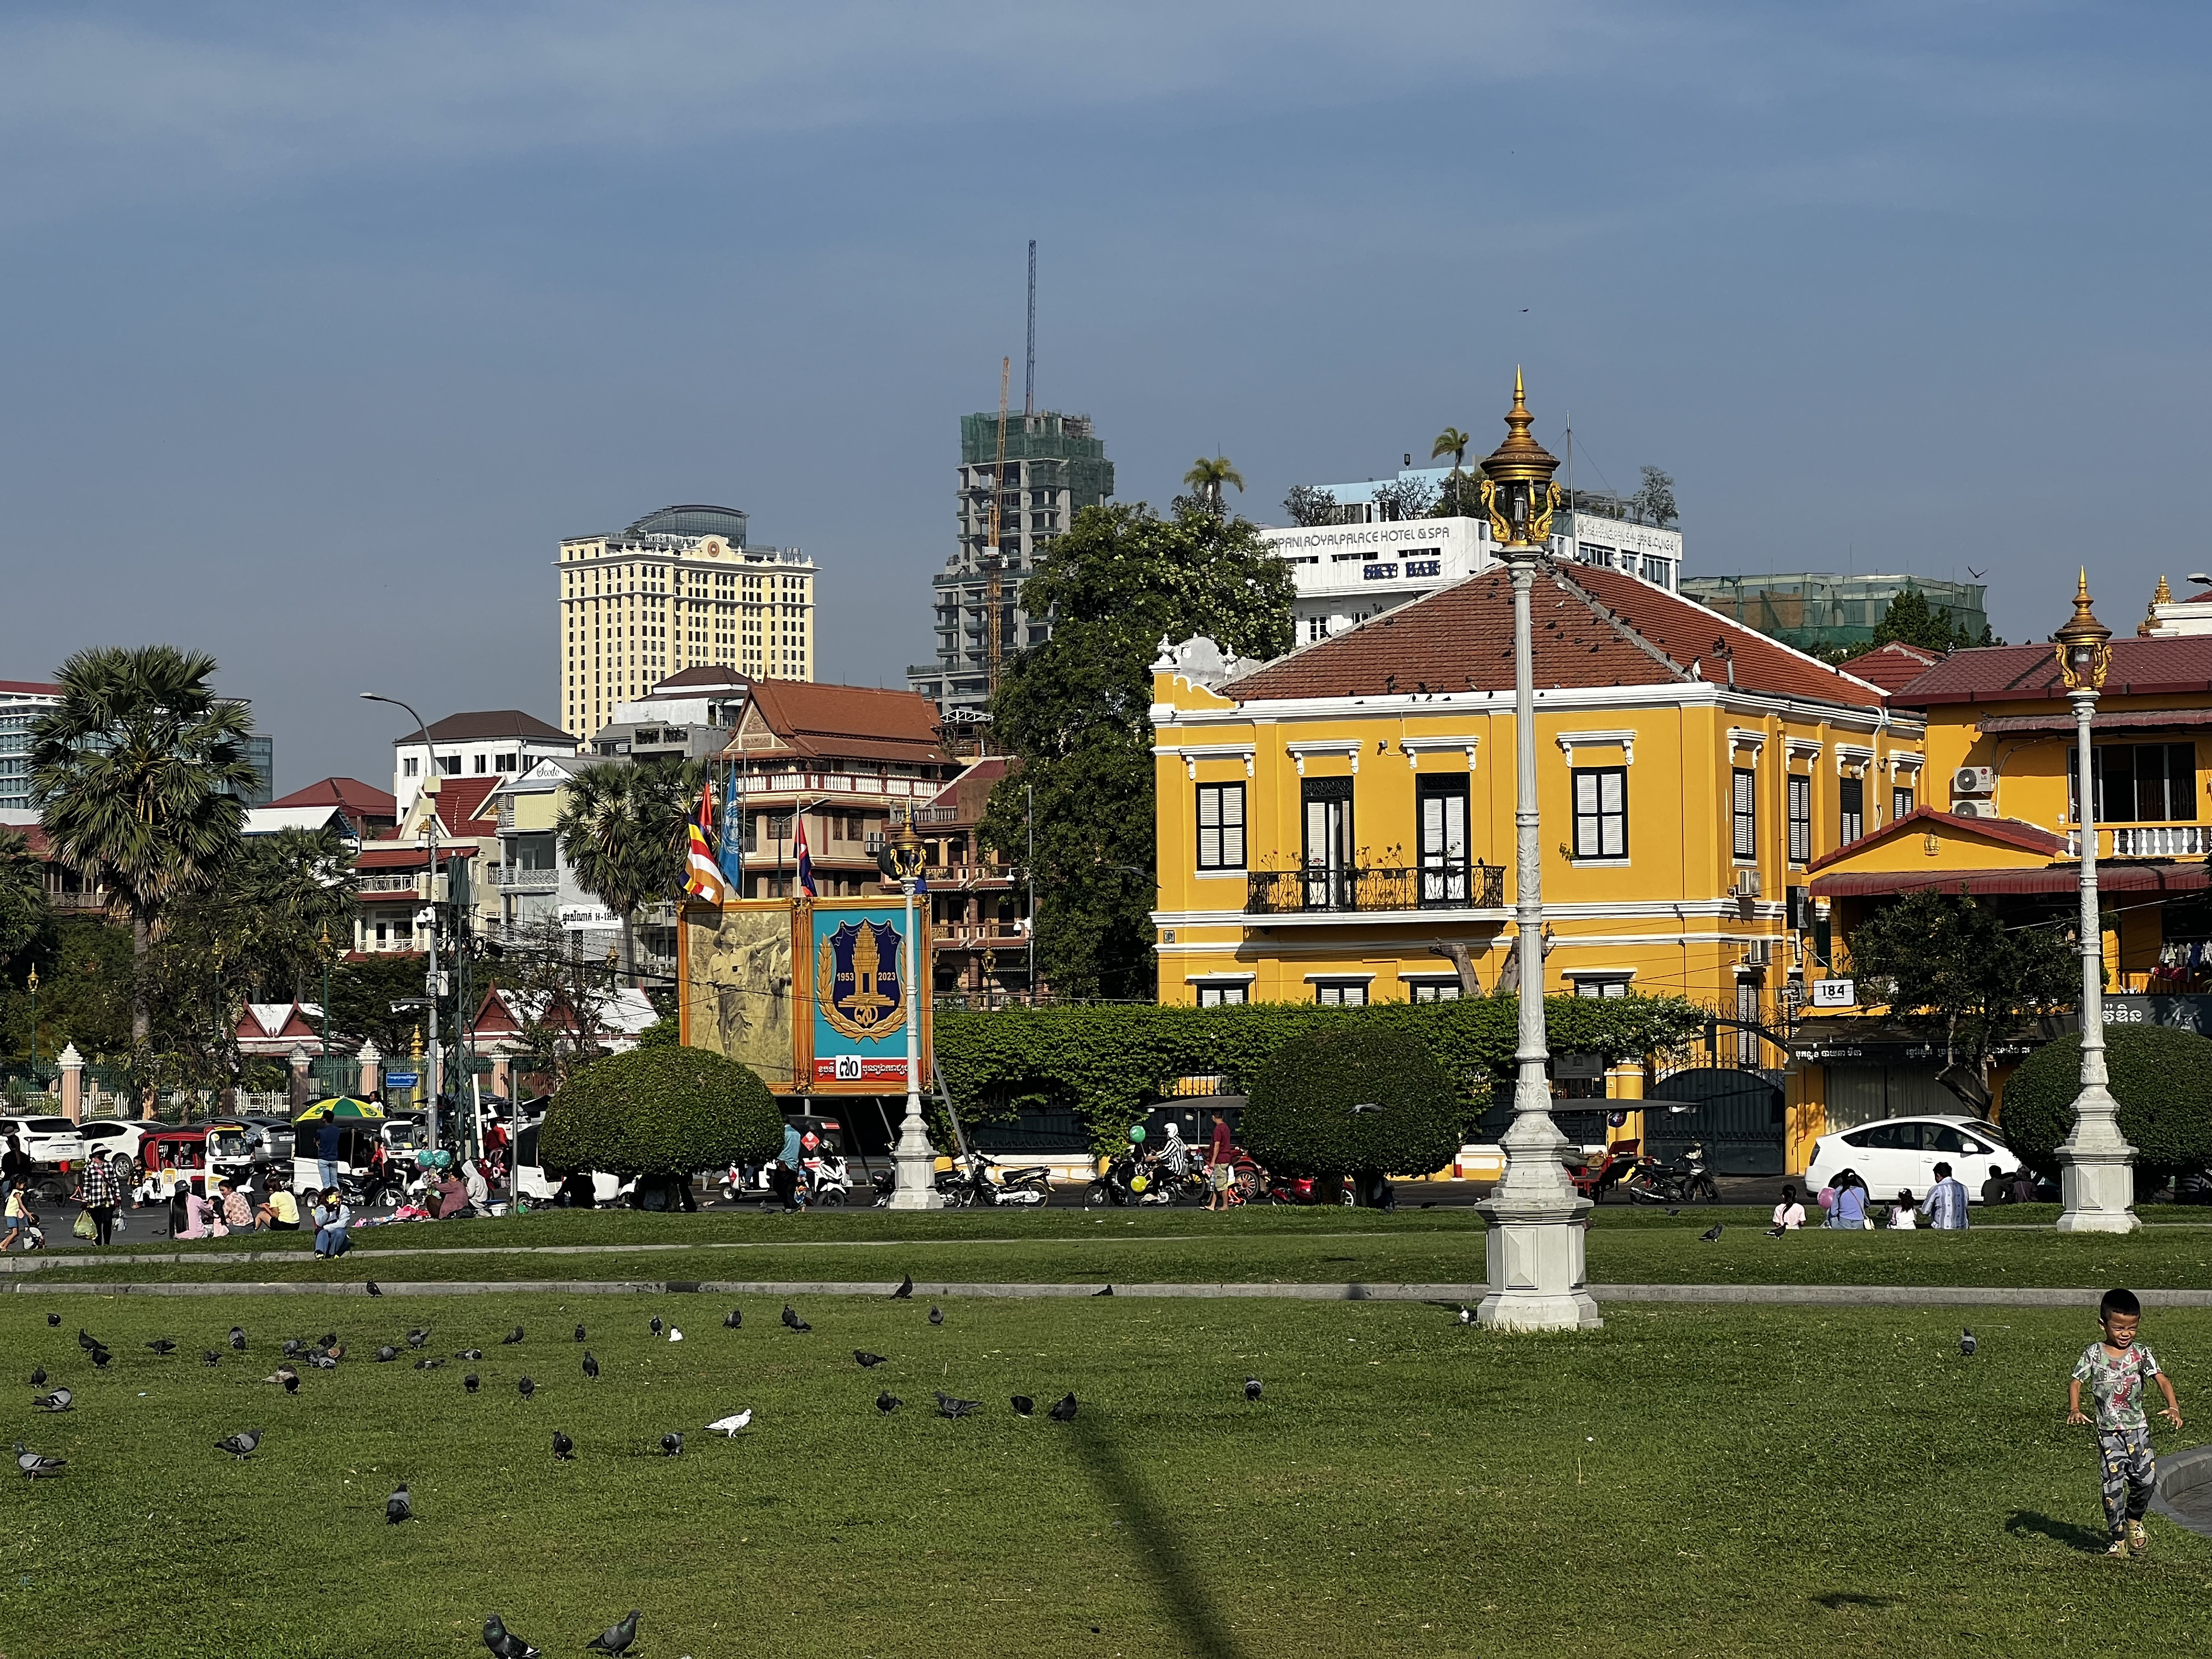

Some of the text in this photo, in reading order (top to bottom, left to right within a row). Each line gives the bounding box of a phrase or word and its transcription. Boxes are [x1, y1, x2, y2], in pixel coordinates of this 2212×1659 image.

[1304, 534, 1339, 547] ROYAL
[1339, 531, 1378, 545] PALACE
[1381, 529, 1415, 541] HOTEL
[1417, 528, 1427, 539] &
[1428, 526, 1450, 539] SPA
[1363, 560, 1441, 580] SKY BAR
[837, 972, 854, 982] 1953
[878, 972, 896, 981] 2023
[1822, 984, 1845, 997] 184
[839, 1056, 858, 1077] ៧០
